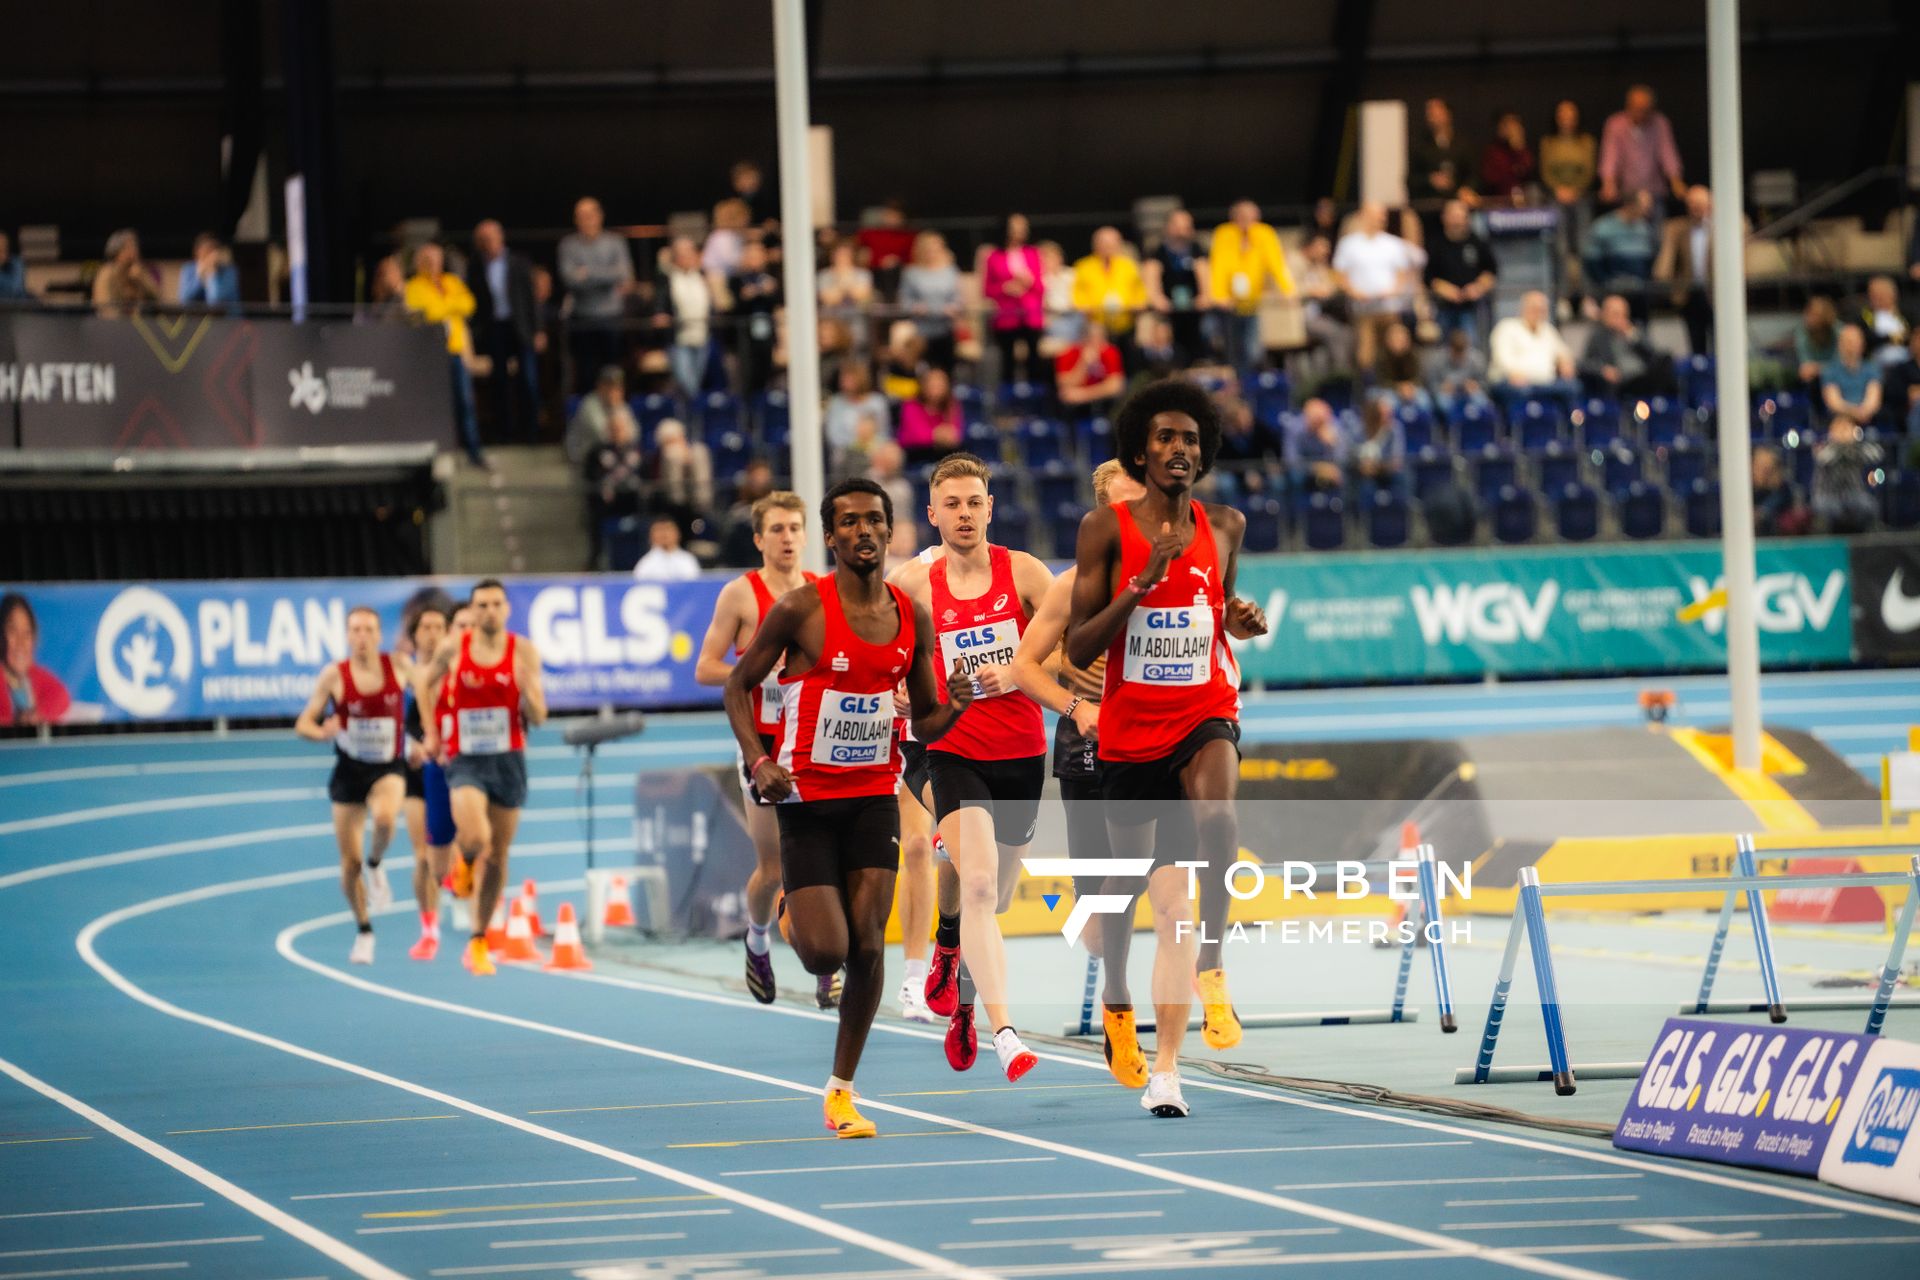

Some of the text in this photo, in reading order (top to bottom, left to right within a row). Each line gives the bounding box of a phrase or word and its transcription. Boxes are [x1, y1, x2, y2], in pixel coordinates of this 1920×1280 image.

[1411, 582, 1559, 645] WGV
[198, 597, 347, 667] PLAN
[1129, 635, 1211, 659] M.ABDILAAHI
[1164, 666, 1192, 675] PLAN
[823, 717, 891, 742] Y.ABDILAAHI
[851, 749, 876, 757] PLAN
[1620, 1117, 1644, 1138] Parcels
[1650, 1119, 1676, 1146] People
[1686, 1123, 1710, 1146] Parcels
[1719, 1125, 1745, 1153] People
[1754, 1130, 1778, 1152] Parcels
[1787, 1131, 1815, 1161] People
